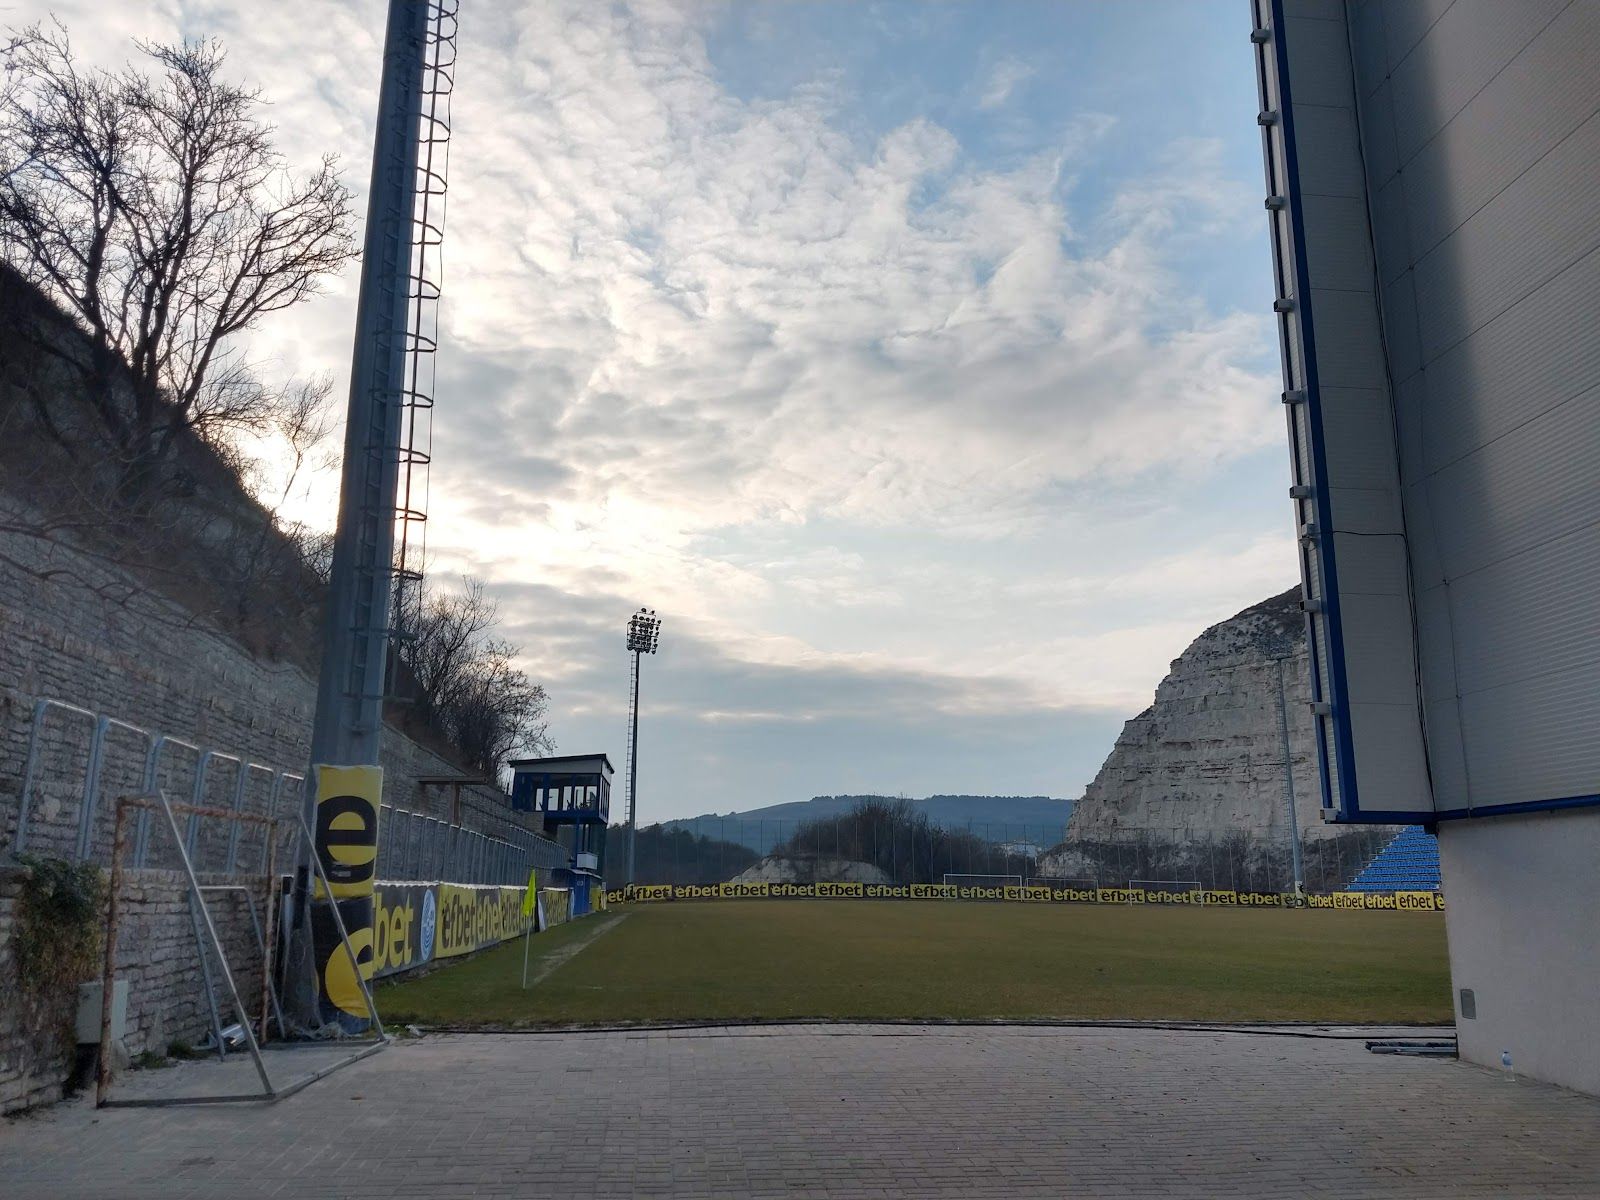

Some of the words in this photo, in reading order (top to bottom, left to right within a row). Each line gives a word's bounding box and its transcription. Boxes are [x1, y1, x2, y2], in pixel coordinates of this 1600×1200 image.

[635, 887, 669, 899] fbet
[675, 884, 718, 897] efbet
[723, 884, 766, 896] efbet
[771, 884, 814, 896] efbet
[819, 884, 861, 896] efbet
[866, 885, 909, 897] efbet
[914, 886, 956, 897] efbet
[961, 886, 1003, 898] efbet
[1008, 888, 1049, 899] efbet
[1053, 889, 1096, 901] efbet
[1101, 891, 1143, 902] efbet
[1147, 891, 1190, 903] efbet
[1194, 893, 1235, 903] efbet
[1239, 893, 1280, 905] efbet
[1309, 894, 1333, 907] efbet
[1336, 895, 1362, 907] efbet
[1367, 895, 1395, 908] efbet
[1400, 893, 1432, 908] efbet
[374, 892, 413, 971] bet
[442, 894, 475, 949] efbet
